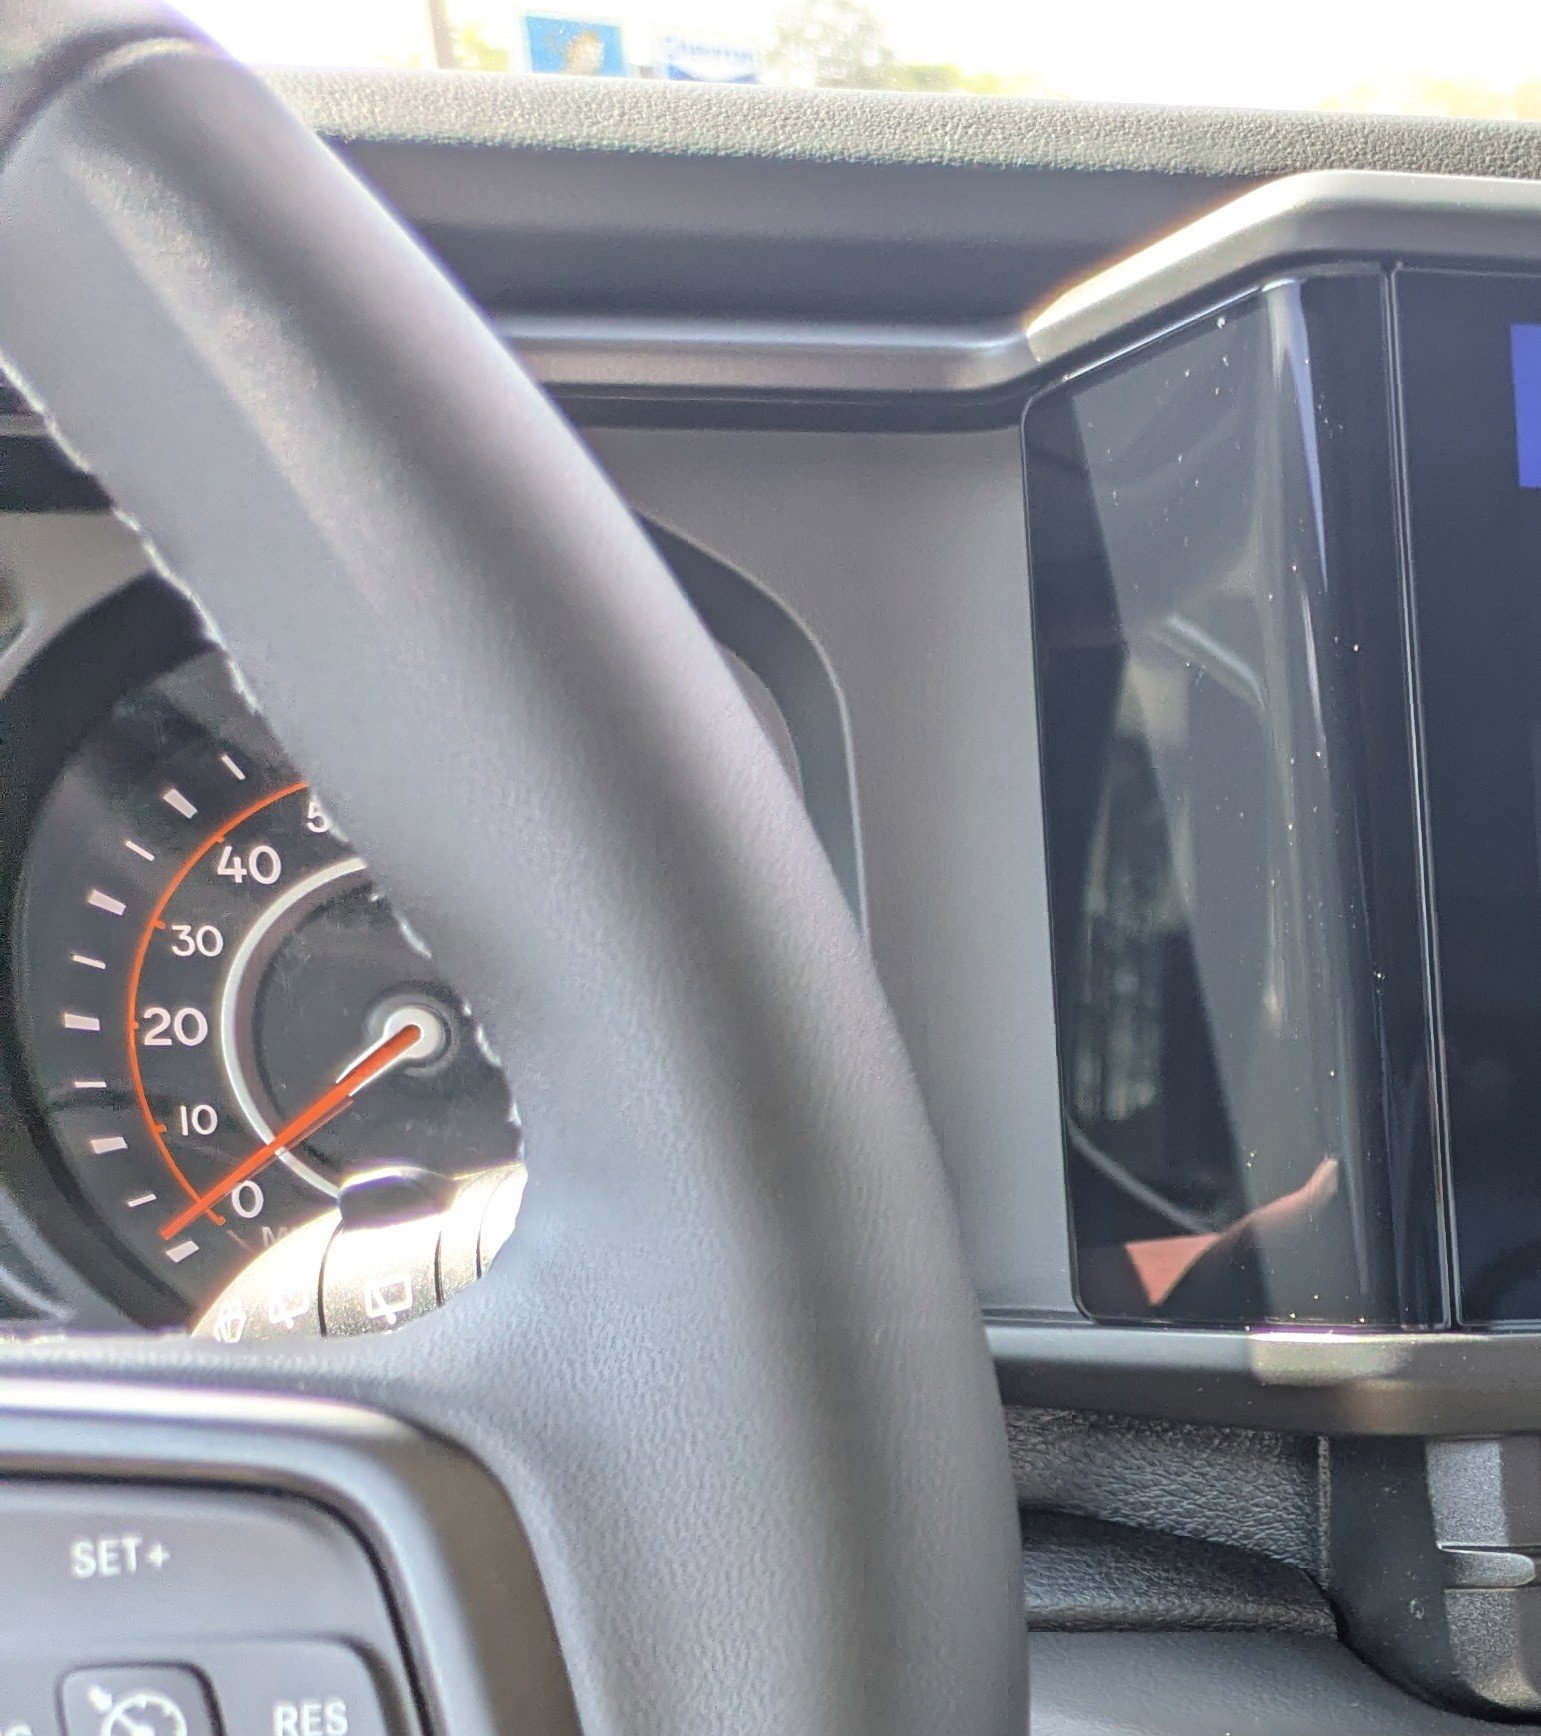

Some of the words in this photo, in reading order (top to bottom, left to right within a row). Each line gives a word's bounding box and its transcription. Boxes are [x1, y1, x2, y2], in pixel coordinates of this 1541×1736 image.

[217, 845, 282, 885] 40
[171, 926, 224, 957] 30
[142, 1007, 208, 1046] 20
[179, 1104, 218, 1137] 10
[231, 1180, 264, 1219] 0
